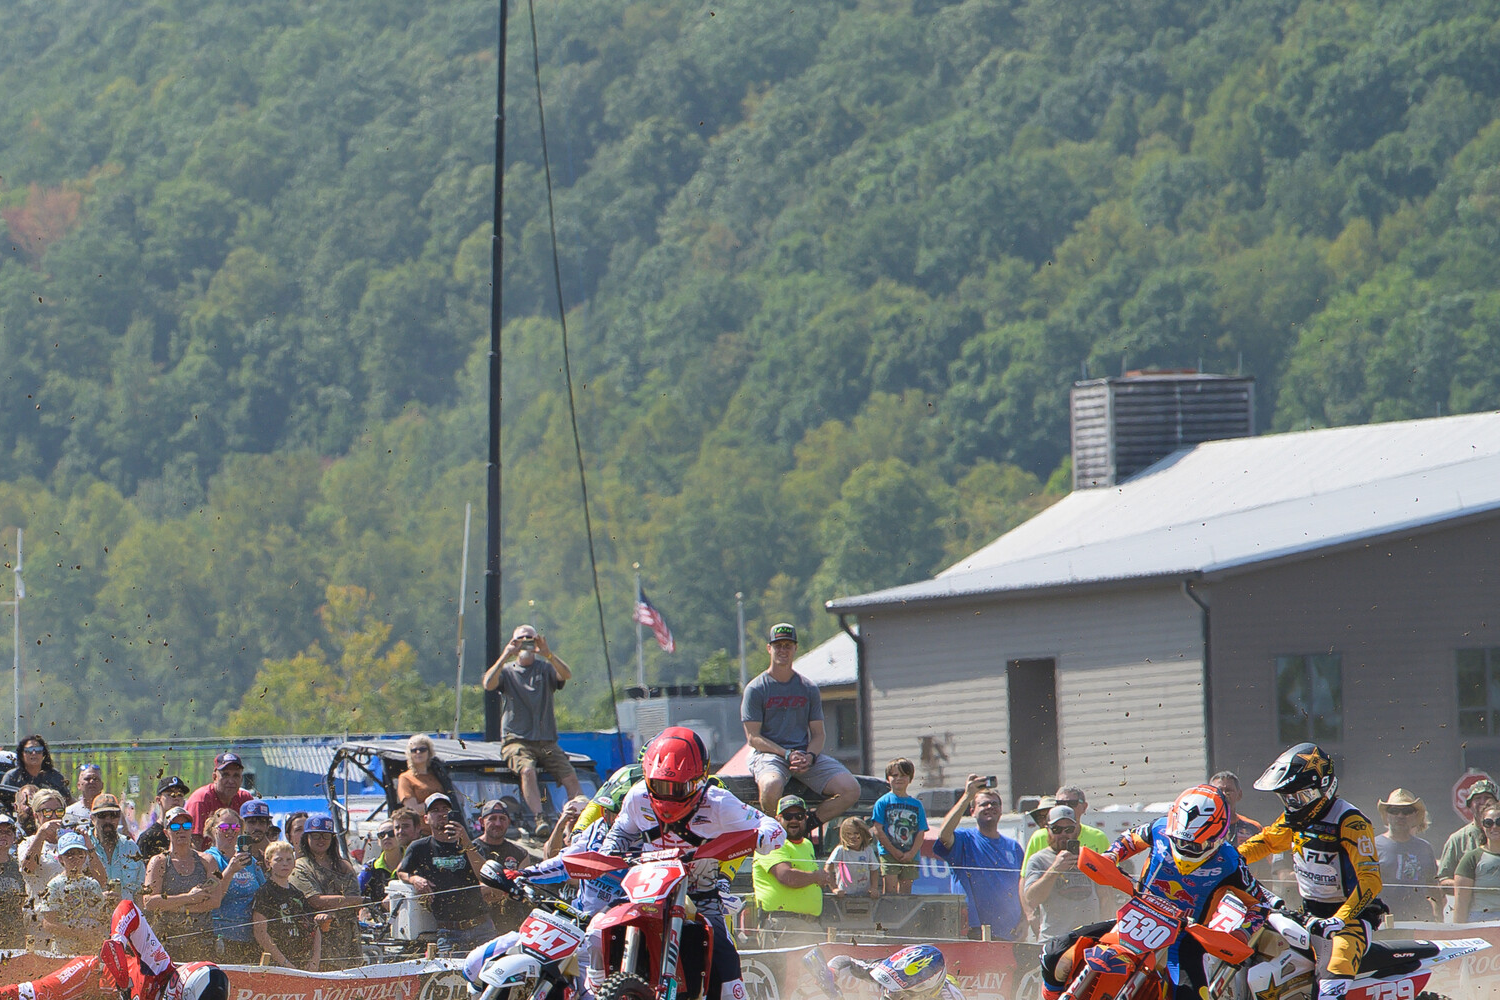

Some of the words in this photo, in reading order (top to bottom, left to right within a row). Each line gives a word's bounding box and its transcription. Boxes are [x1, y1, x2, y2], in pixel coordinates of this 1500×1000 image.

[765, 695, 807, 709] FXR
[1307, 853, 1337, 865] FLY
[633, 866, 669, 899] 3
[1118, 909, 1172, 949] 530
[522, 921, 580, 956] 347
[1220, 949, 1235, 957] KTM
[1448, 947, 1479, 960] DUNLOP
